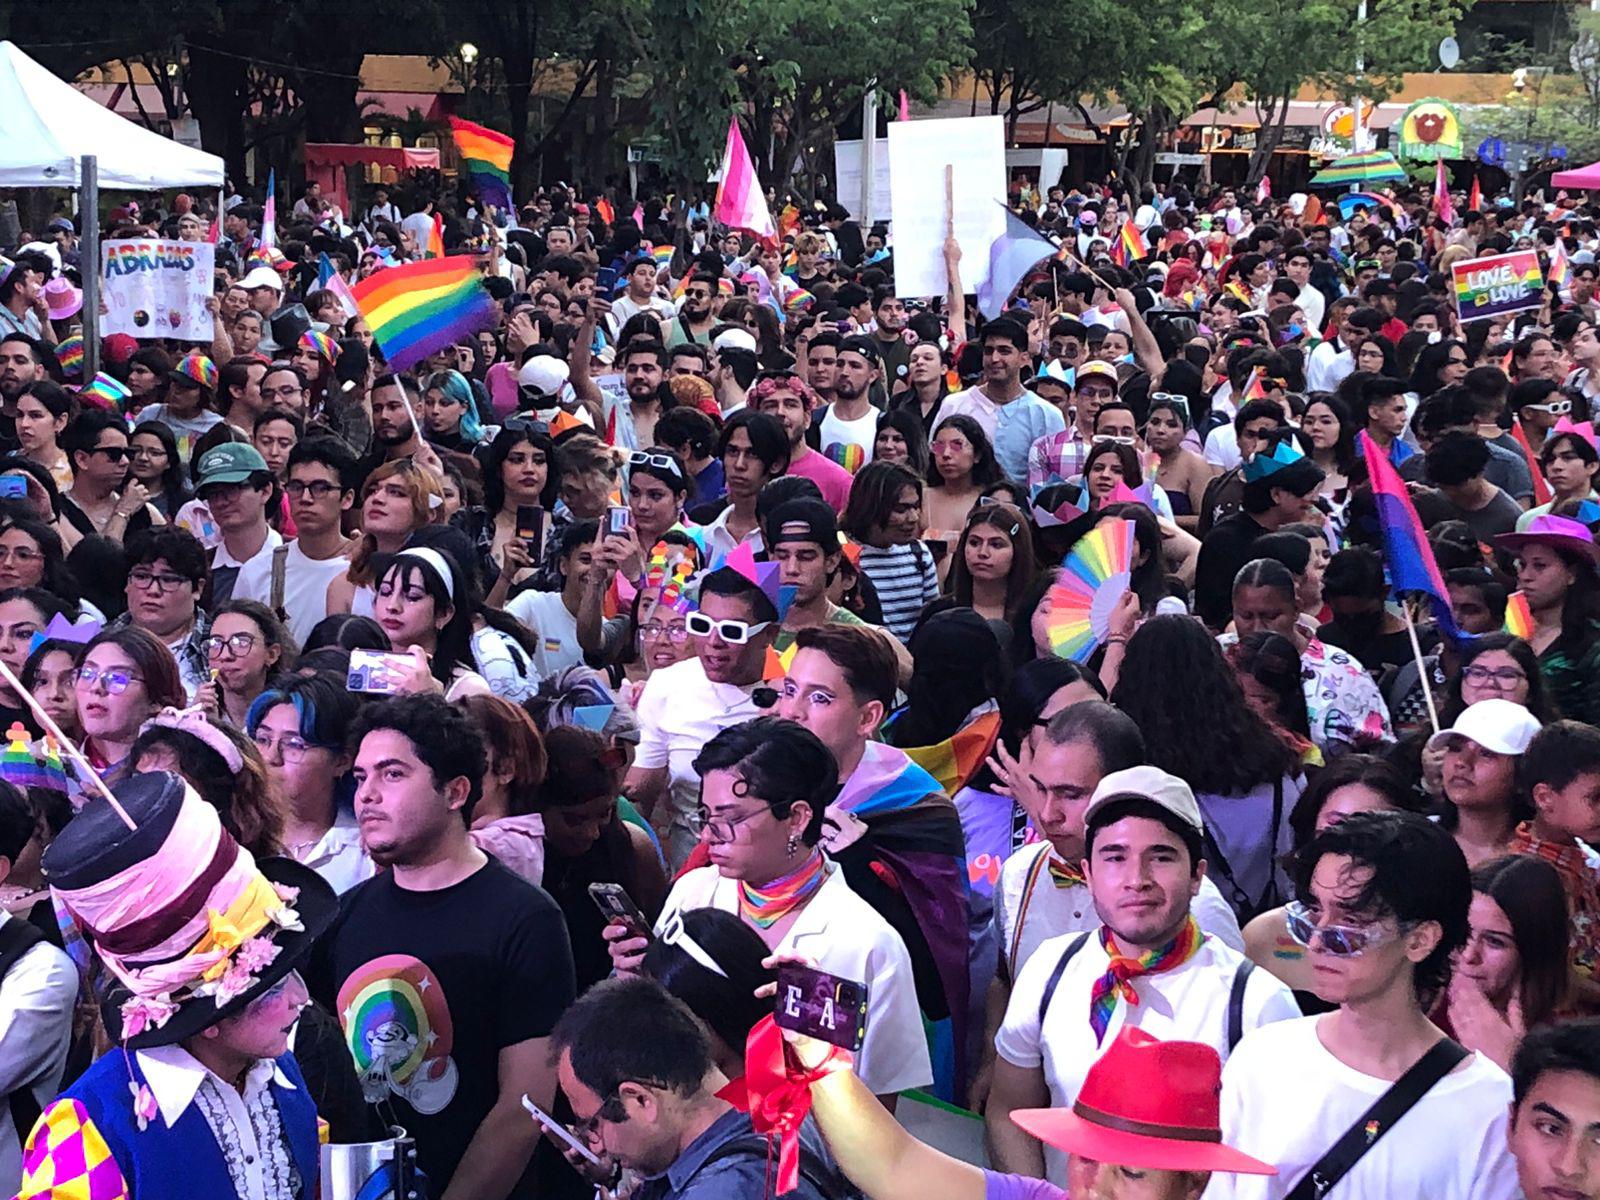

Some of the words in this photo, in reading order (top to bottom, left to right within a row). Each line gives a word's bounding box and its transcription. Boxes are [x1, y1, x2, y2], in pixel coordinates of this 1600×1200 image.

[1466, 264, 1514, 291] LOVE
[1488, 280, 1533, 304] LOVE
[785, 984, 802, 1018] E
[819, 996, 836, 1030] A
